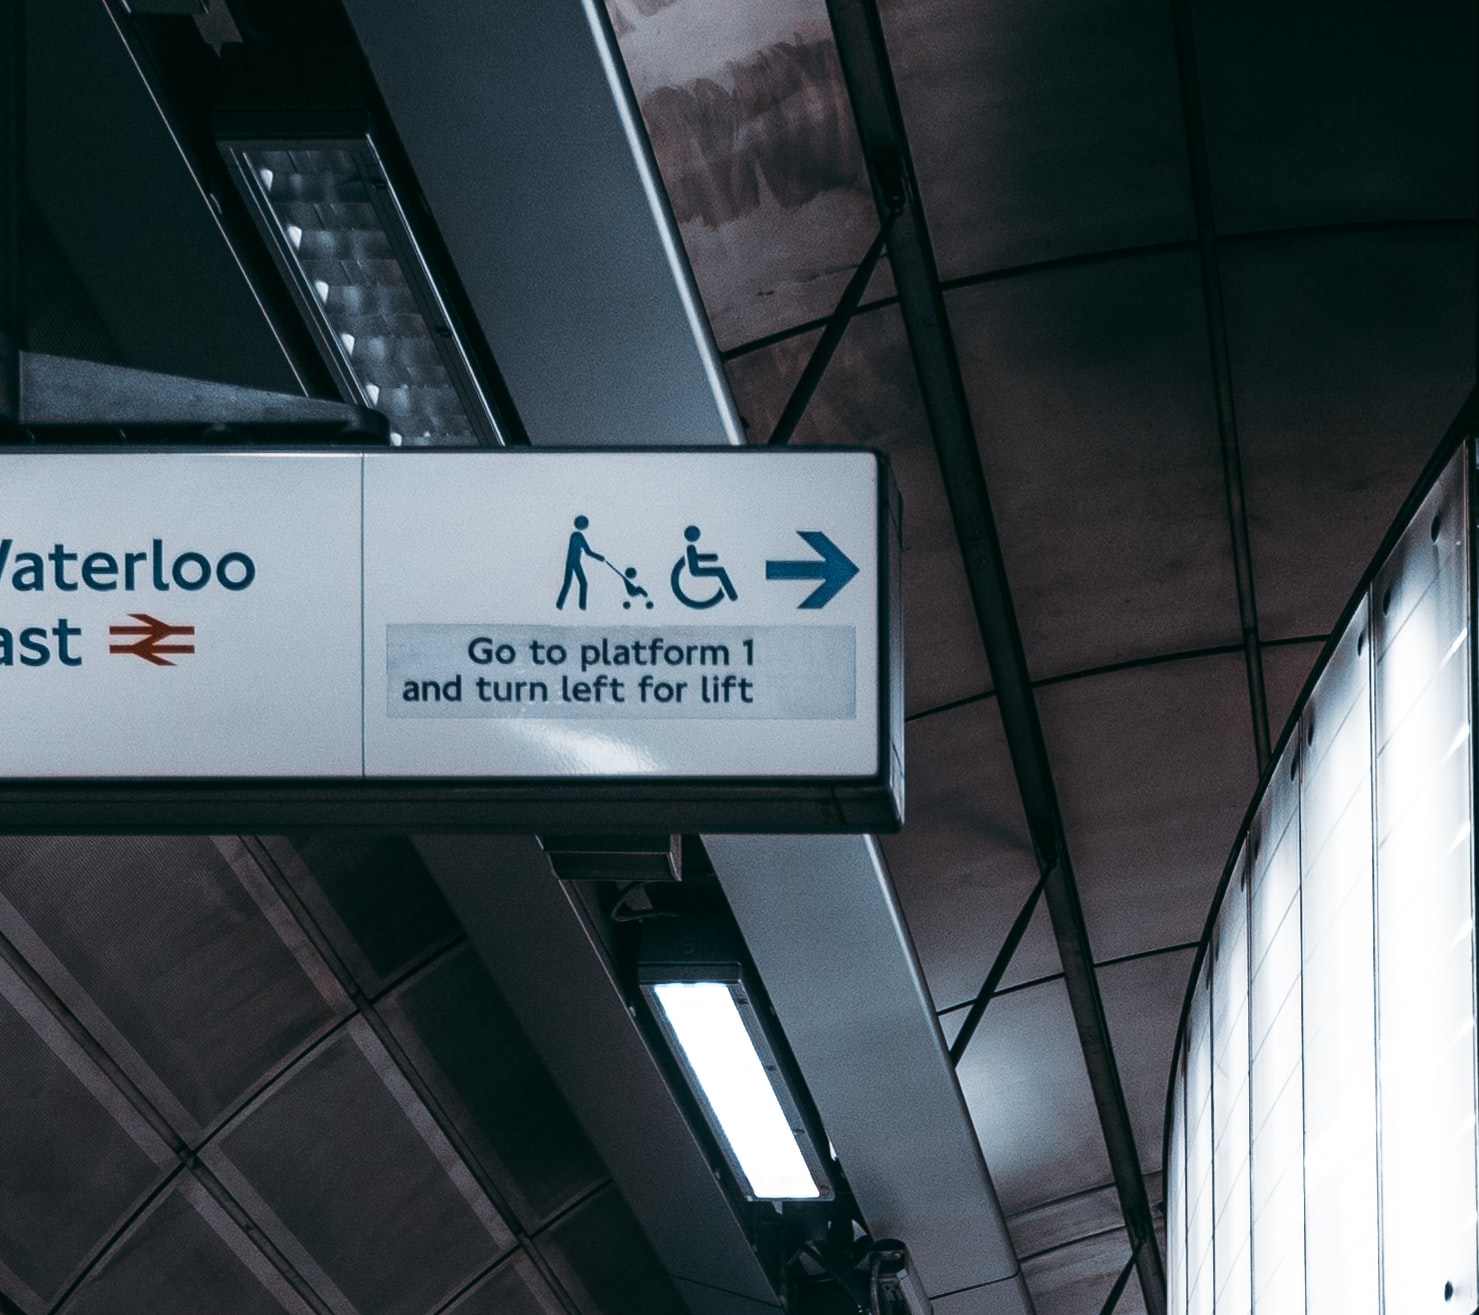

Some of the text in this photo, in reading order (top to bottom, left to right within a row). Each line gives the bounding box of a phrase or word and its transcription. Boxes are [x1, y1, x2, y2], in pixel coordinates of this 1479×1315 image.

[466, 636, 755, 673] Go to platform 1
[401, 674, 754, 704] and turn left for lift
